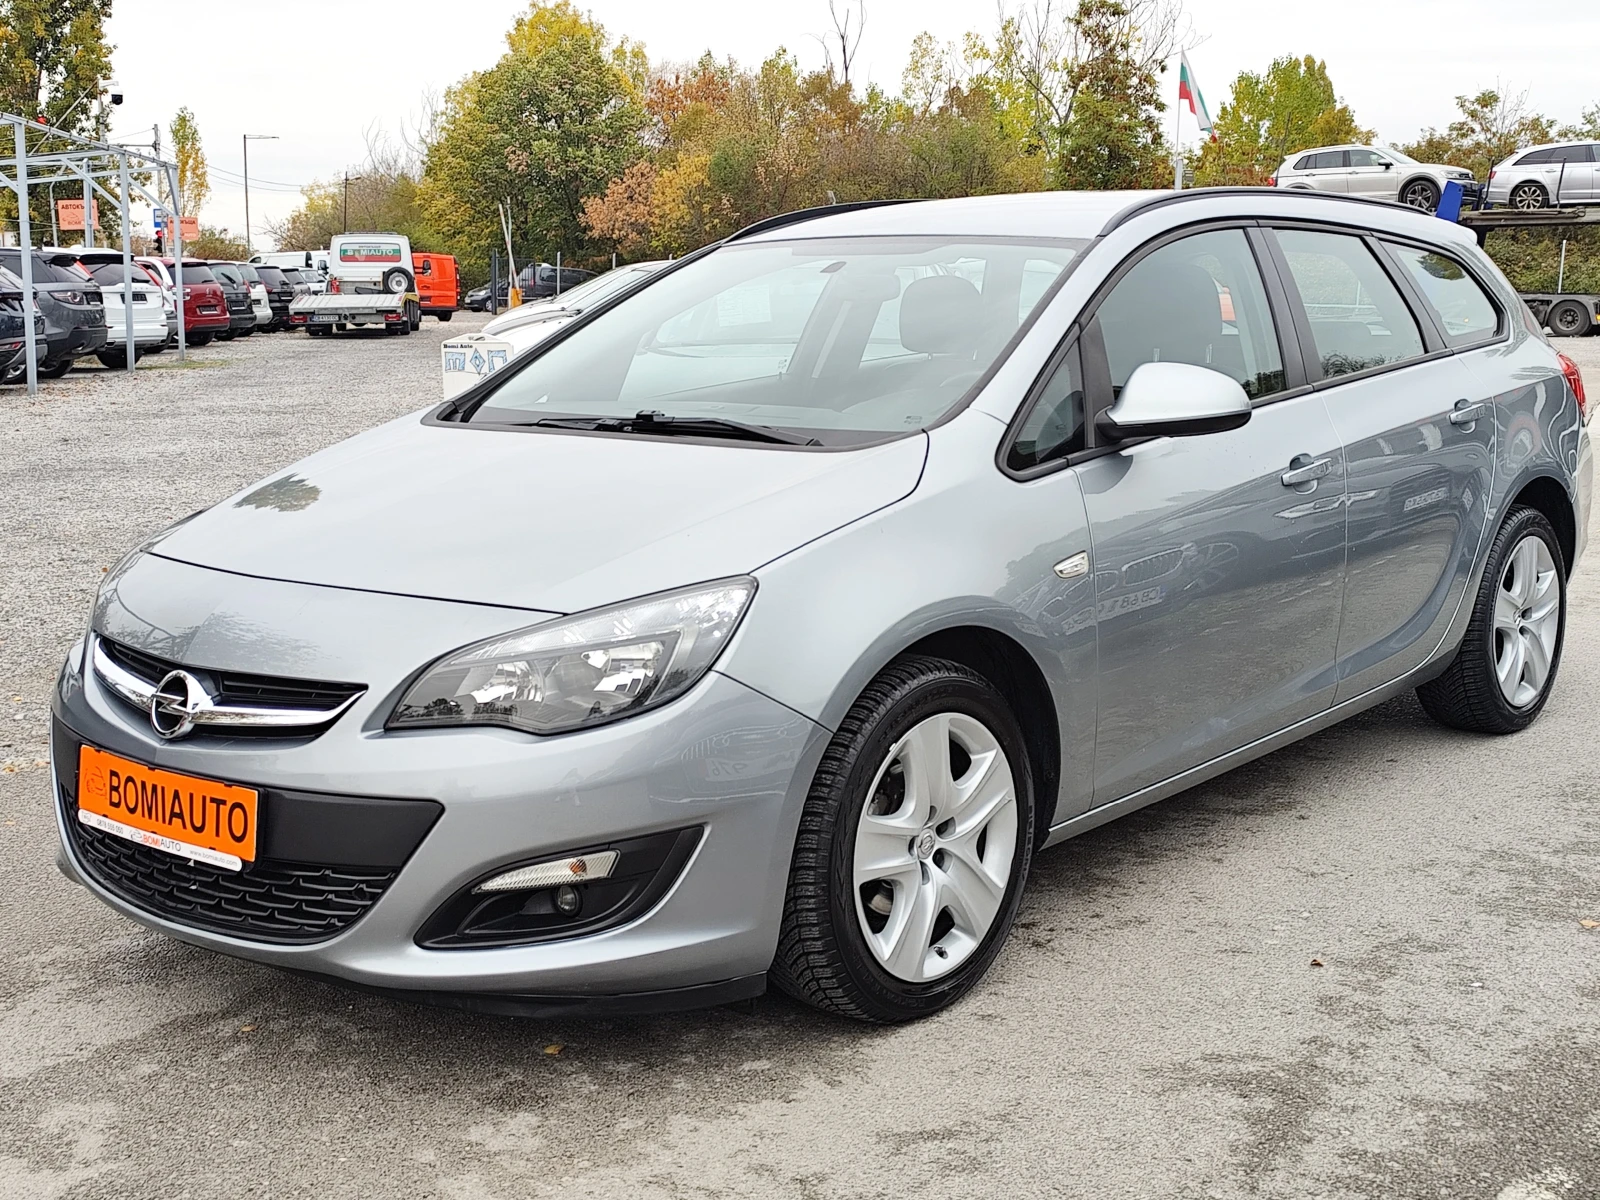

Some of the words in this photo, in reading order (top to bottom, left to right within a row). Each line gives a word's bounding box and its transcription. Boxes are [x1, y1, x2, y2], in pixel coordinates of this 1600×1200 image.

[109, 769, 248, 844] BOMIAUTO
[142, 834, 182, 852] BOMIAUTO
[189, 849, 238, 867] www.bomiauto.com
